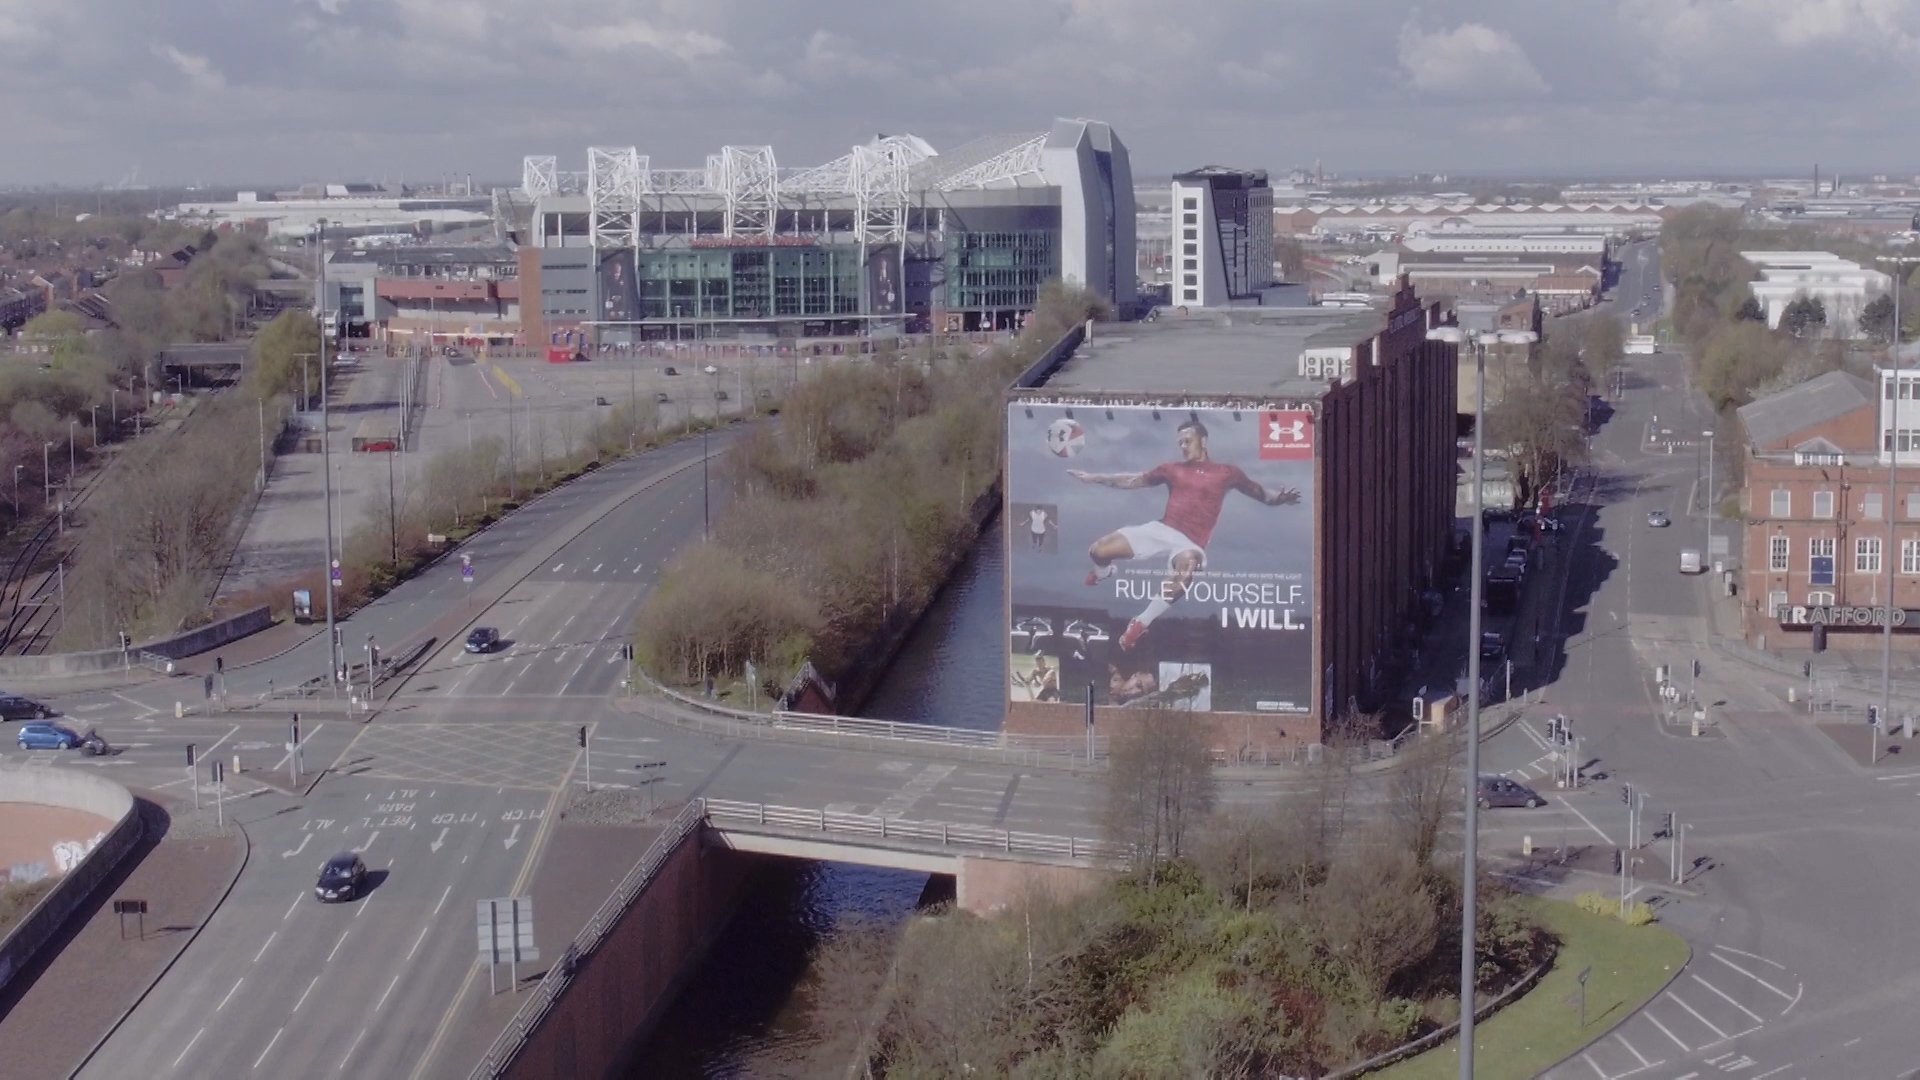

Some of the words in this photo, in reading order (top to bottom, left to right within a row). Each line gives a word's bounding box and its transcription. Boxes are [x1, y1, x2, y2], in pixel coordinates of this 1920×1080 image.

[1115, 579, 1175, 600] RULE
[1179, 581, 1305, 604] YOURSELF.
[1221, 607, 1228, 628] I
[1234, 607, 1305, 630] WILL.
[1778, 606, 1906, 626] TRAFFORD
